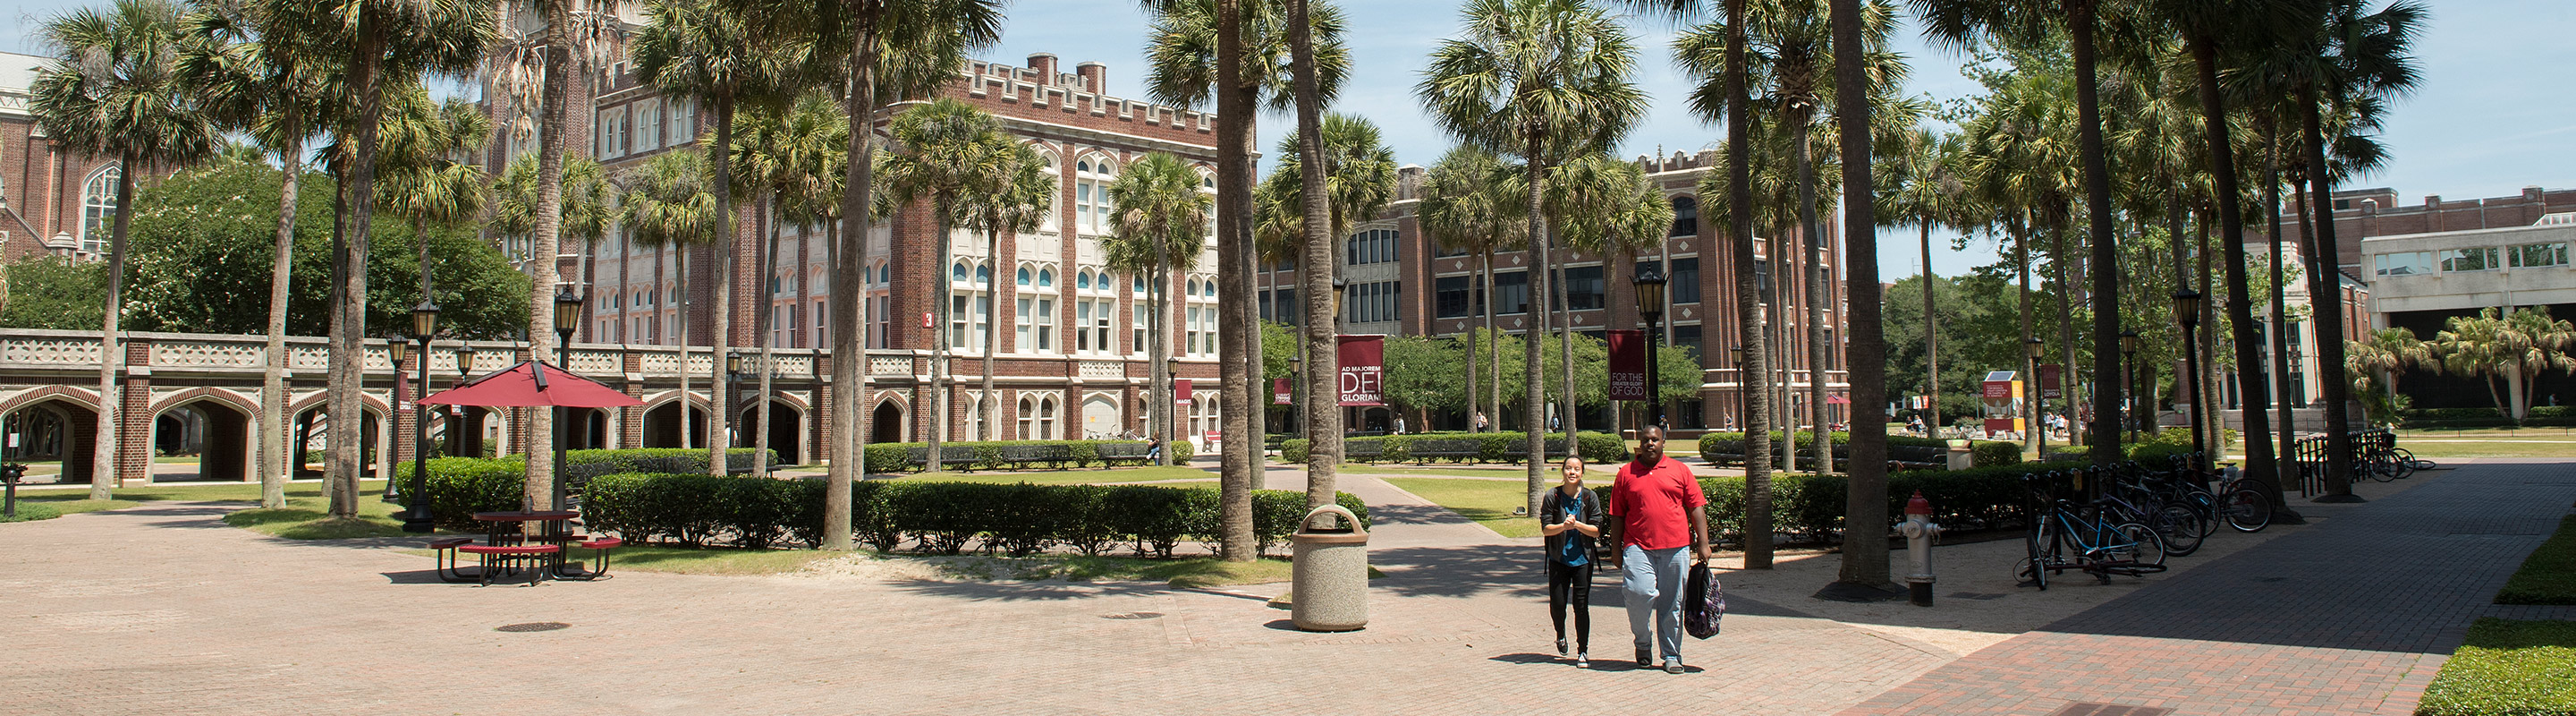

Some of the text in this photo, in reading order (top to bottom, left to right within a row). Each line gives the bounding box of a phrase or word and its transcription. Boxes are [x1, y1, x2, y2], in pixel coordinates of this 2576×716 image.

[926, 313, 932, 327] 3
[1612, 372, 1643, 382] FOR THE
[1342, 371, 1381, 394] DEI
[1611, 386, 1644, 396] OF GOD
[1342, 394, 1382, 402] GLORIAM
